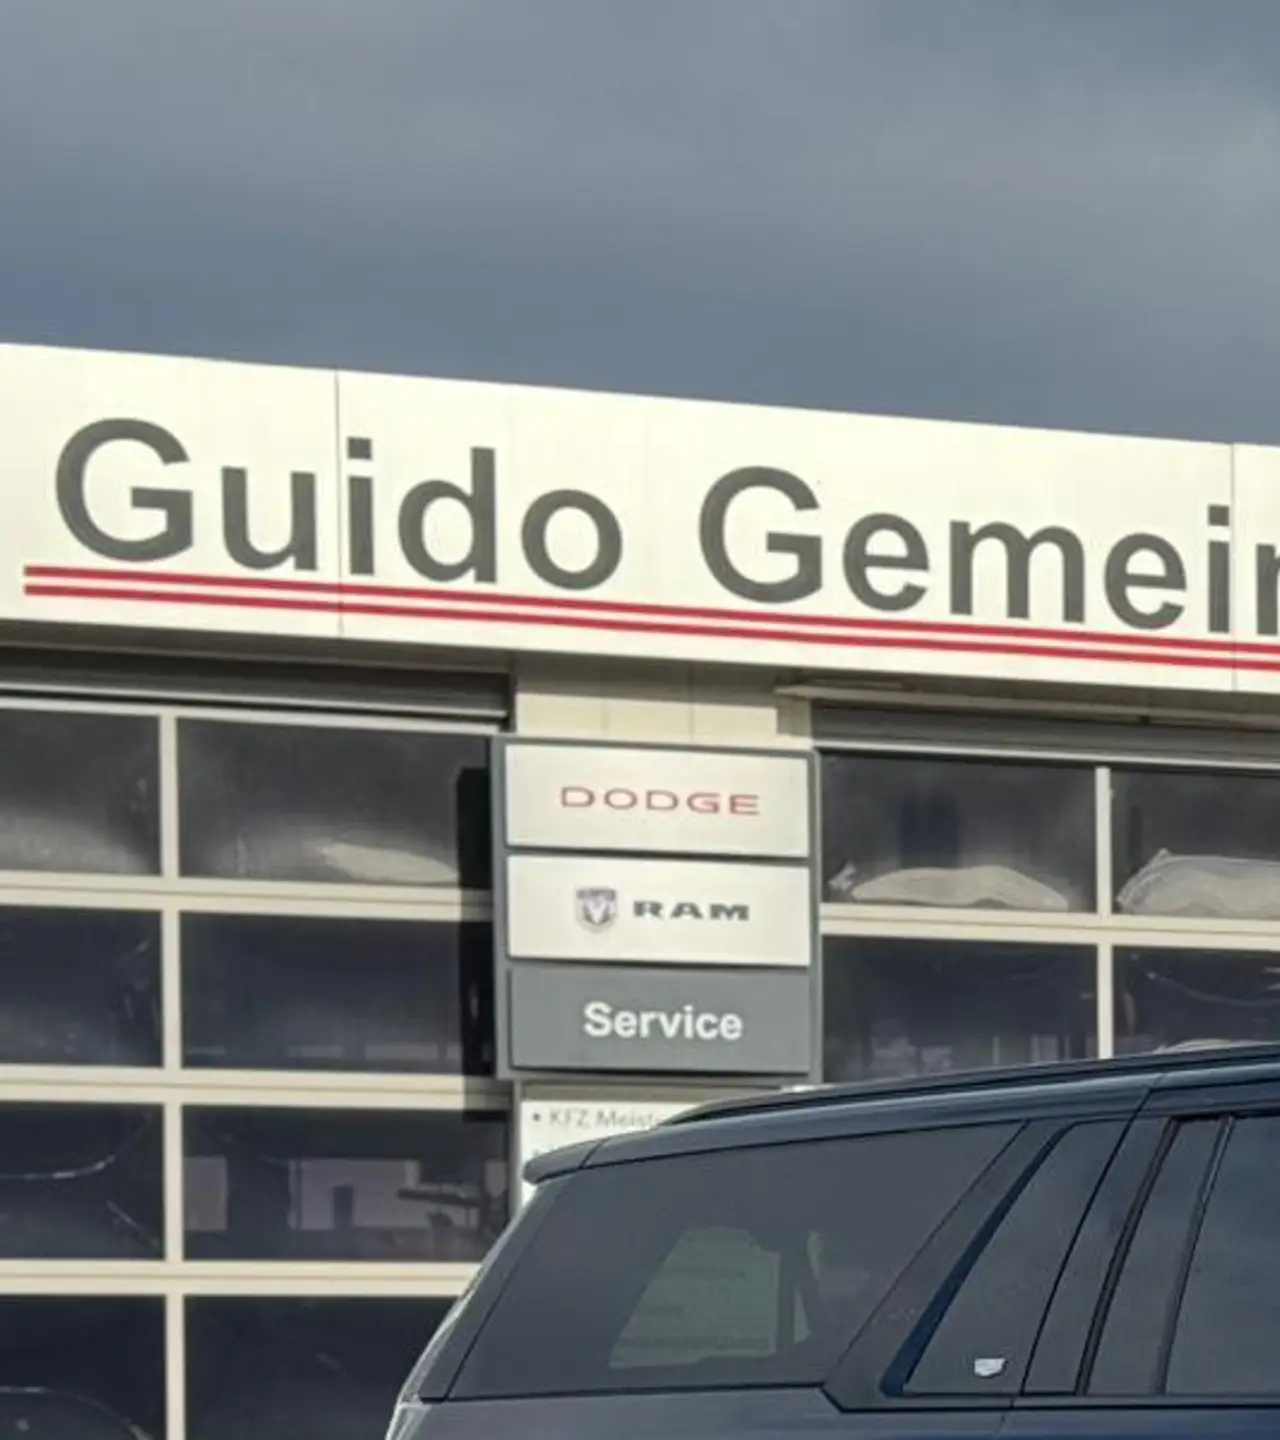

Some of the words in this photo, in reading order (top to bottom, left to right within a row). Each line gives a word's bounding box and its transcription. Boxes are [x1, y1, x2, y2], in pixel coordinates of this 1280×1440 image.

[55, 417, 623, 592] Guido
[560, 786, 761, 816] DODGE
[633, 900, 750, 921] RAM
[583, 1001, 743, 1041] Service
[549, 1107, 591, 1129] KFZ
